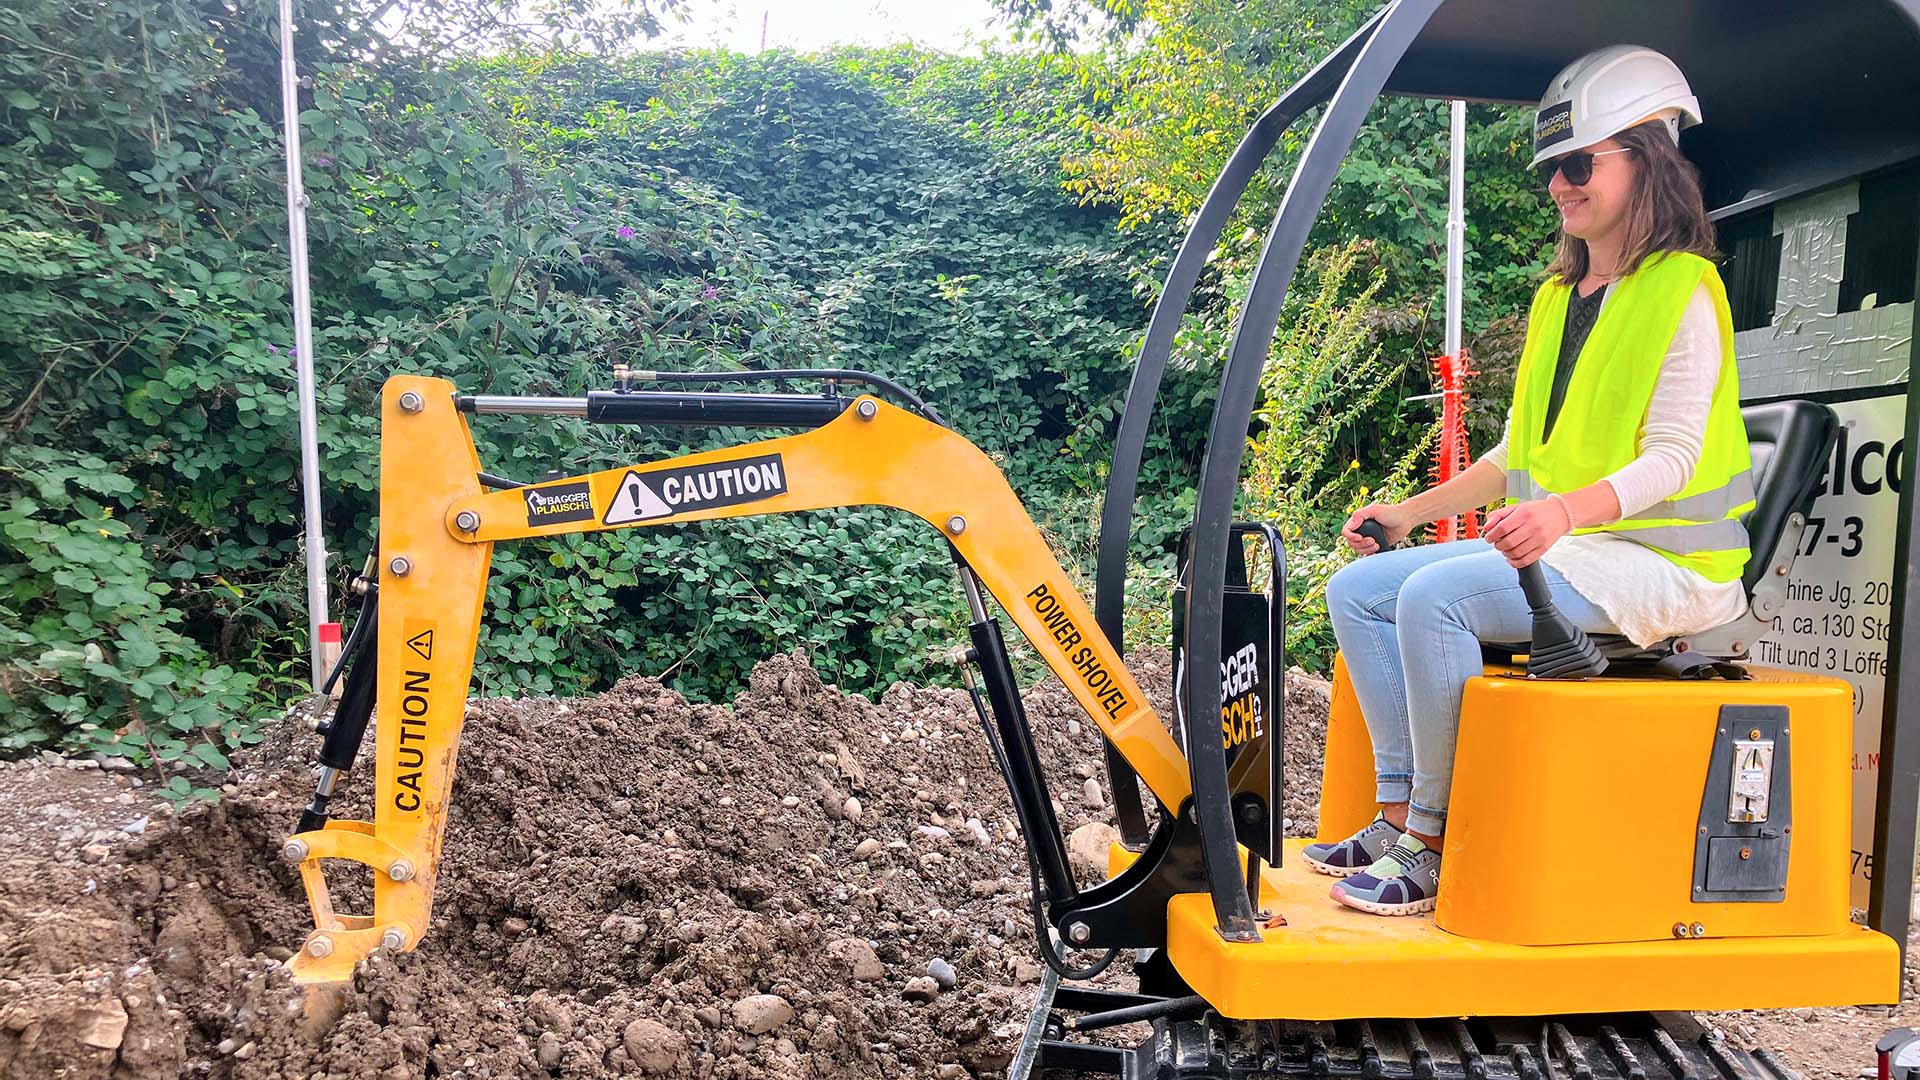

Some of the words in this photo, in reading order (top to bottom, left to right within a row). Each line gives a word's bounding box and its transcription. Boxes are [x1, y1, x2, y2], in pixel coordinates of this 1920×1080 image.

[547, 492, 588, 505] BAGGER
[663, 462, 781, 505] CAUTION
[536, 501, 585, 515] PLAUSCH
[1796, 516, 1864, 557] 7-3
[1786, 578, 1824, 602] hine
[1829, 580, 1856, 610] Jg.
[1863, 581, 1892, 606] 20
[1792, 616, 1817, 636] ca.
[1822, 613, 1855, 638] 130
[1027, 583, 1082, 652] POWER
[1071, 647, 1128, 720] SHOVEL
[1760, 640, 1782, 664] Tilt
[1787, 646, 1820, 669] und
[1825, 647, 1837, 670] 3
[395, 670, 431, 812] CAUTION
